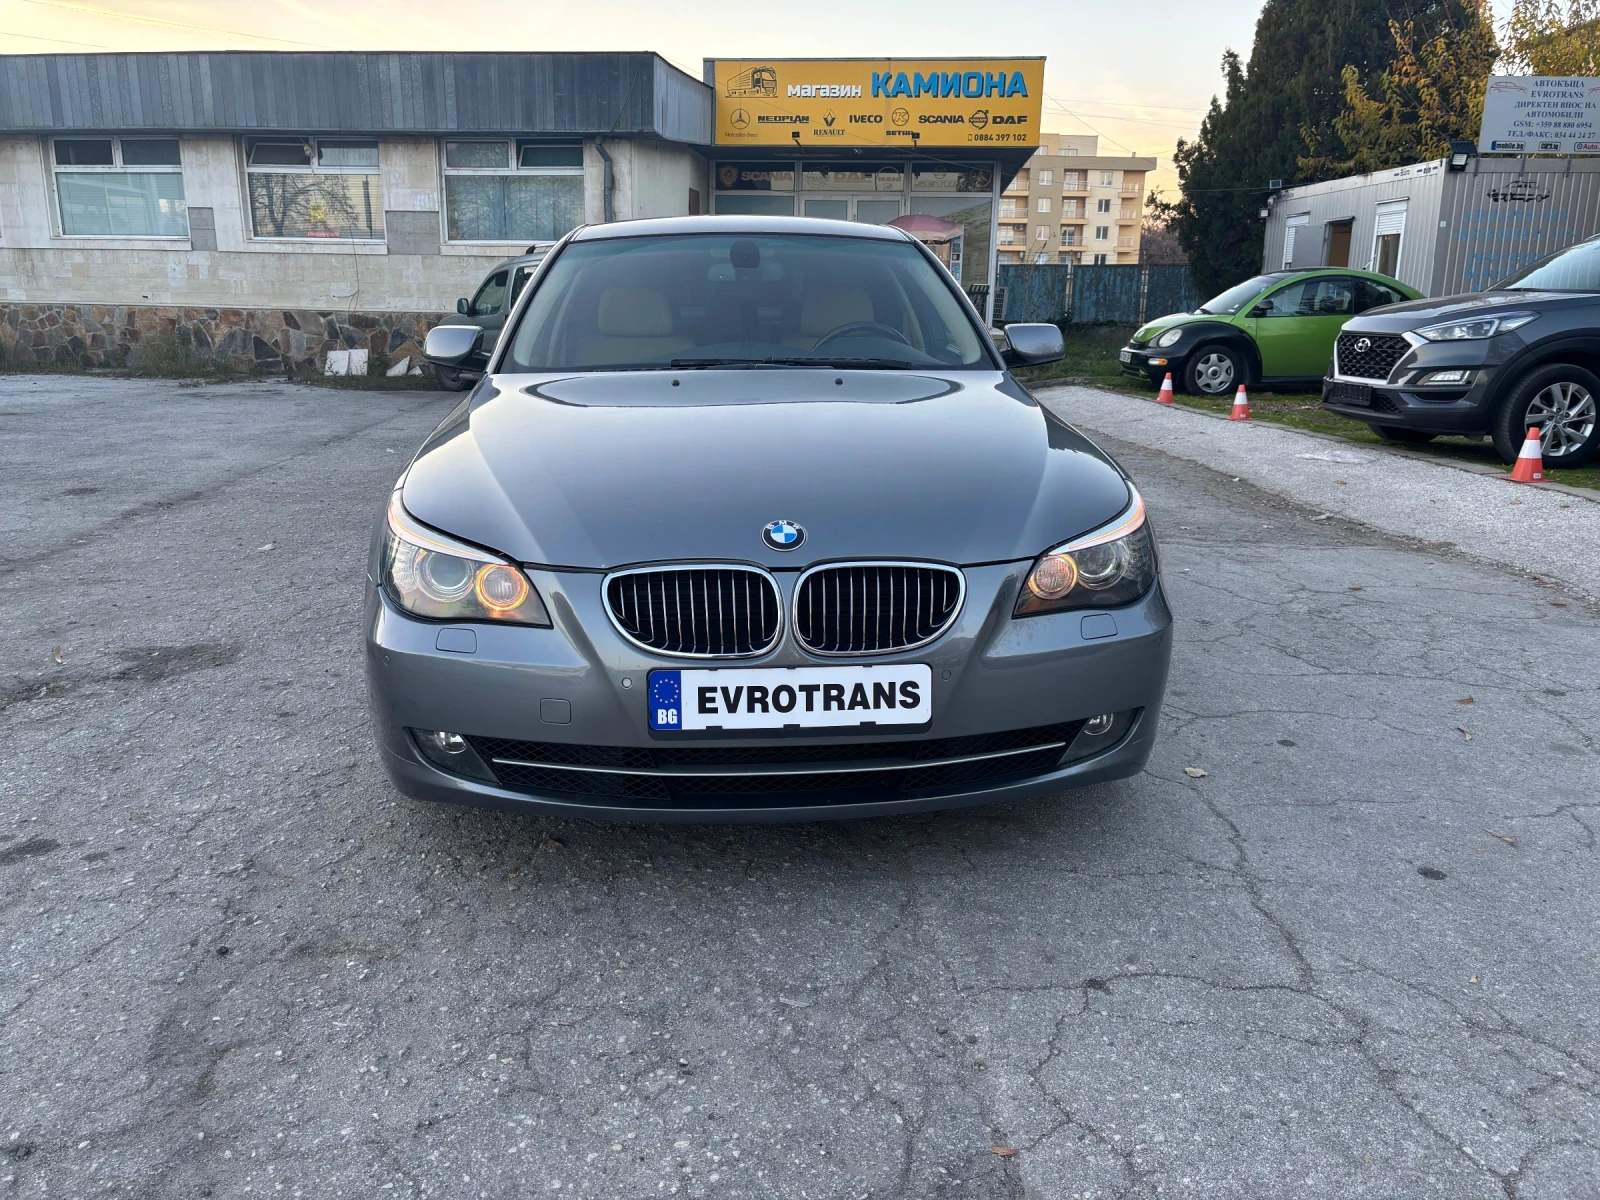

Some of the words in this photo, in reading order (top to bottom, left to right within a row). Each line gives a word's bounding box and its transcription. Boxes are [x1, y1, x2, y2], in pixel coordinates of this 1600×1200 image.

[787, 84, 862, 97] магазин
[871, 71, 1028, 98] КАМИОНА
[1532, 79, 1585, 88] АВТОКЪЩА
[1530, 90, 1584, 98] EVROTRANS
[1513, 101, 1558, 109] ДИРЕКТЕН
[1560, 101, 1583, 109] ВНОС
[1584, 101, 1597, 109] НА
[758, 115, 809, 123] NEOPLAN
[849, 115, 883, 123] IVECO
[918, 114, 965, 123] SCANIA
[1524, 111, 1584, 119] АВТОМОБИЛИ
[992, 115, 1028, 124] DAF
[974, 133, 994, 141] 0884
[995, 133, 1010, 141] 397
[1012, 133, 1027, 141] 102
[1496, 142, 1524, 150] mobile.bg
[741, 170, 794, 181] SCANIA
[697, 680, 921, 714] EVROTRANS
[657, 708, 678, 725] BG
